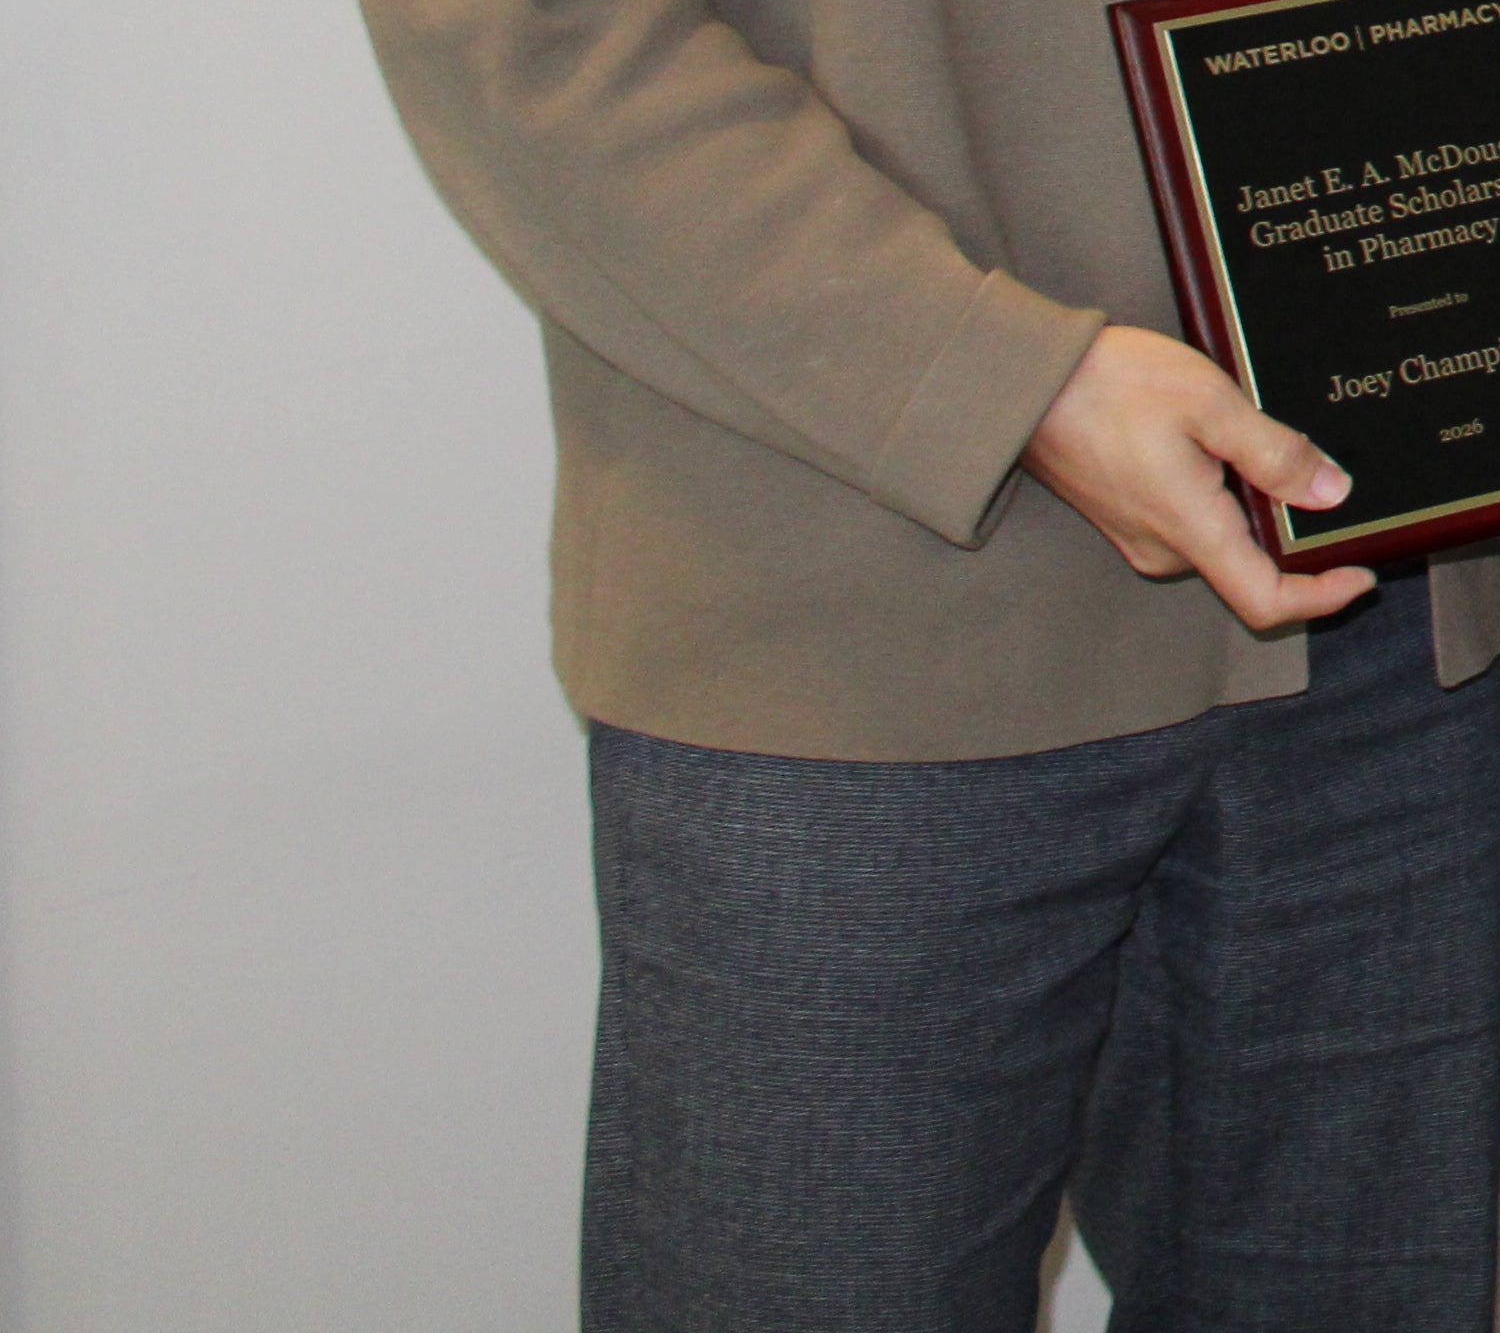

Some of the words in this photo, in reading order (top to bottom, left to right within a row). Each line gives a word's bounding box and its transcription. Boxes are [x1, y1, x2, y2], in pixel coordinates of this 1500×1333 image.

[1204, 33, 1351, 75] WATERLOO
[1237, 175, 1319, 213] Janet
[1320, 167, 1354, 195] E.
[1361, 161, 1392, 188] A.
[1251, 204, 1385, 249] Graduate
[1323, 246, 1355, 273] in
[1359, 217, 1500, 265] Pharmacy
[1389, 293, 1453, 318] Presented
[1454, 292, 1470, 305] to
[1328, 370, 1394, 403] Joey
[1439, 418, 1484, 442] 2026
